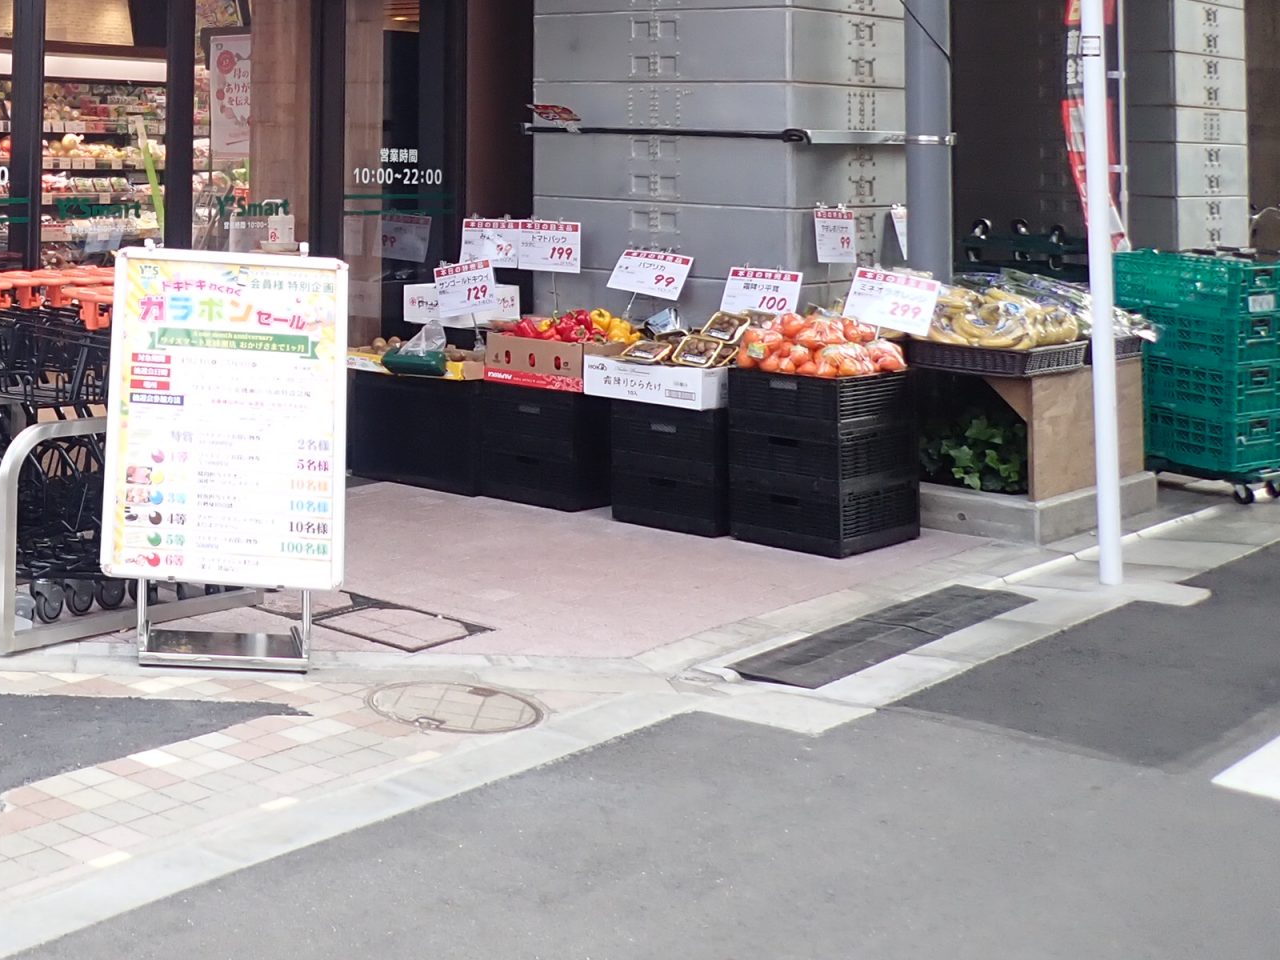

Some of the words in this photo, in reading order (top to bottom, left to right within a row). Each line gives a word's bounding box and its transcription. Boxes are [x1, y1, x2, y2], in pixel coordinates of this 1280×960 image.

[380, 148, 418, 163] 営業時間
[550, 246, 573, 260] 199
[251, 278, 284, 290] 会員様
[288, 280, 334, 293] 特別企画
[439, 274, 489, 289] サンゴールドキウイ
[654, 274, 675, 287] 99
[467, 284, 488, 301] 129
[758, 295, 787, 311] 100
[890, 301, 922, 319] 299
[256, 310, 306, 330] セール
[603, 375, 661, 391] 霜降りひらたけ
[296, 459, 329, 472] 5名様
[289, 500, 328, 513] 10名様
[167, 513, 187, 525] 4等
[288, 521, 328, 535] 10名様
[165, 533, 185, 546] 5等
[280, 541, 328, 556] 100名様
